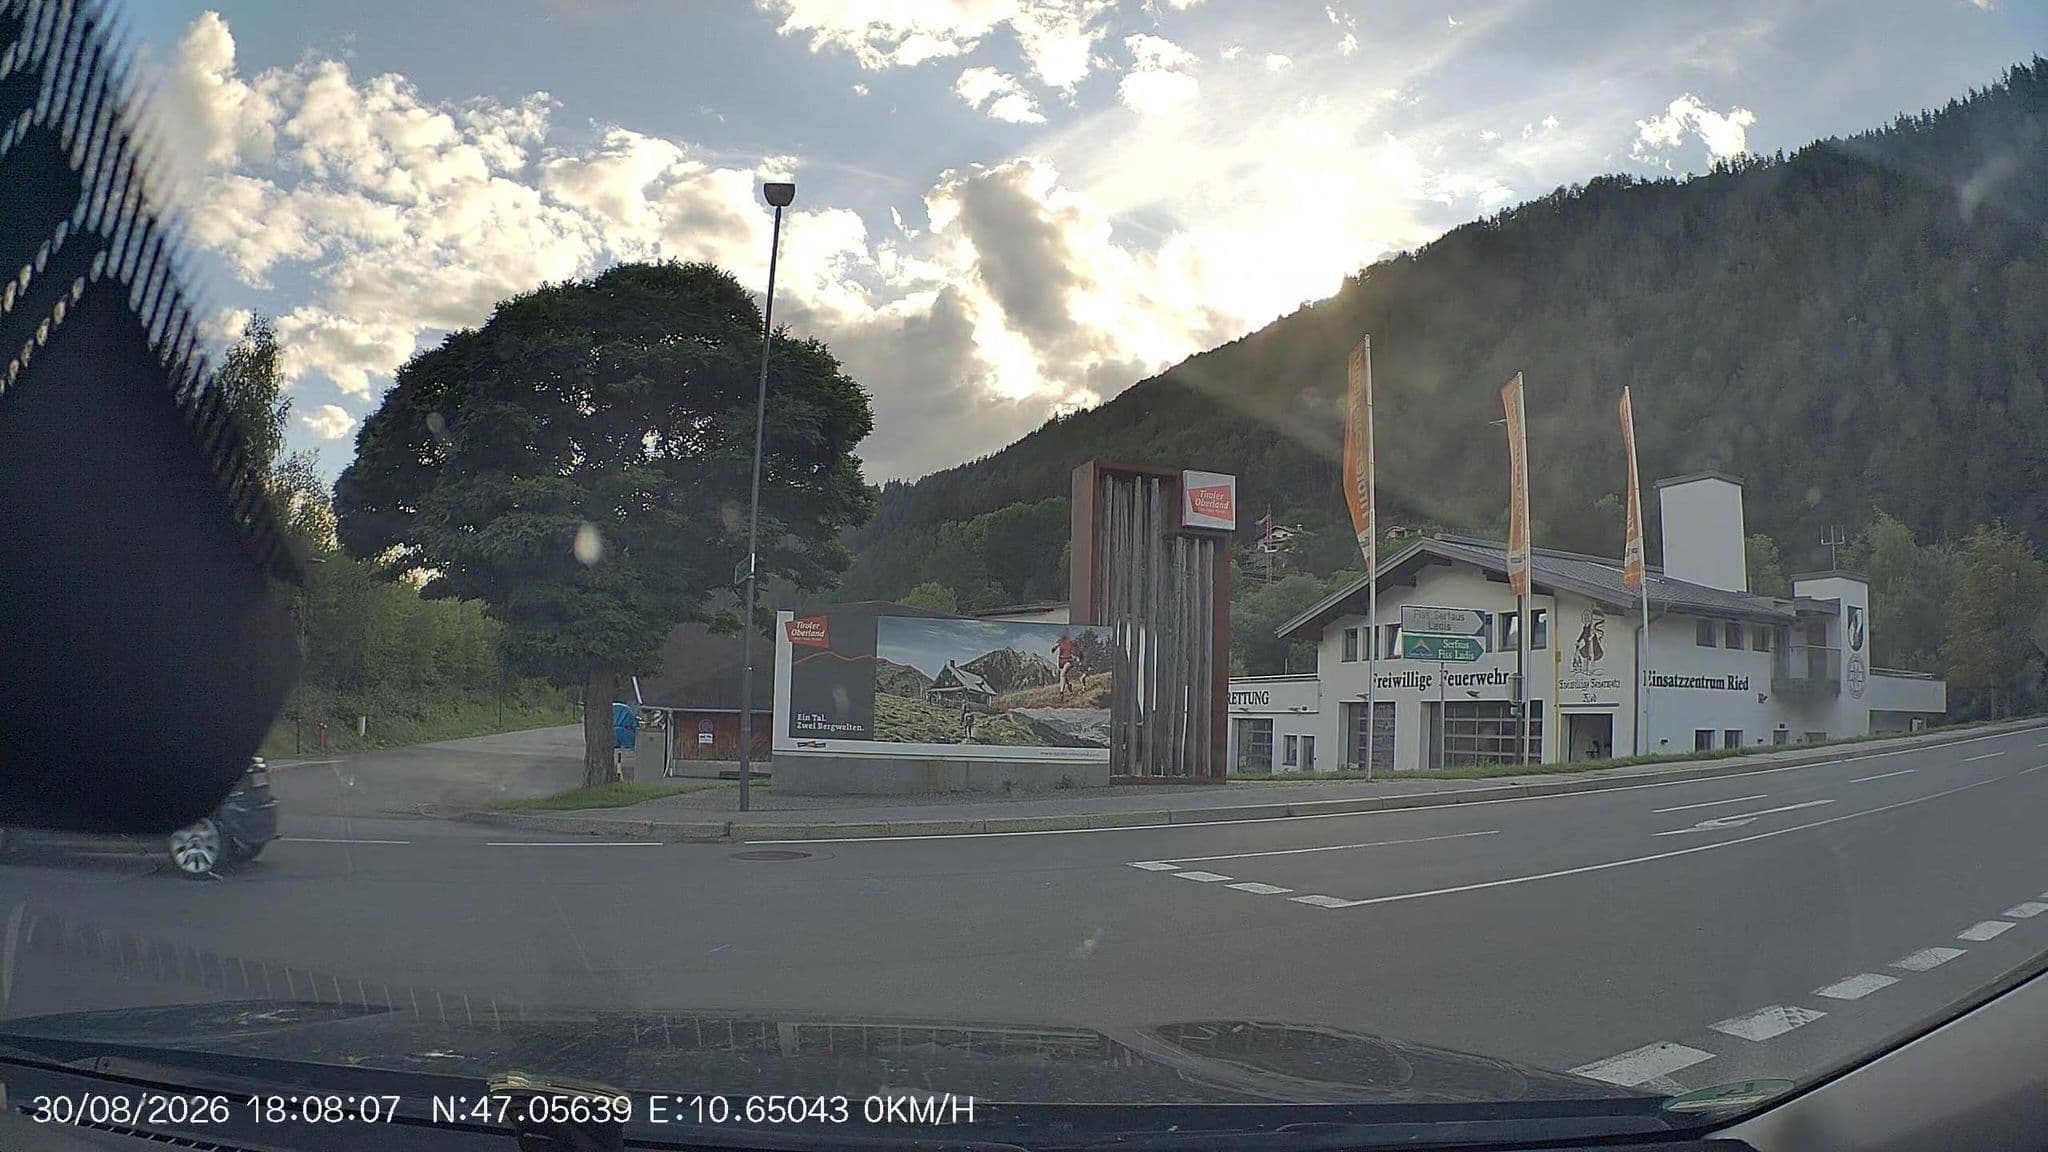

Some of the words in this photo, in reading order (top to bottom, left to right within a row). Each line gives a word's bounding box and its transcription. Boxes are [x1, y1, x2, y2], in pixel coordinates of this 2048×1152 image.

[1200, 489, 1224, 500] Tiroler
[1194, 497, 1230, 510] Oberland
[796, 621, 820, 630] Tiroler
[791, 628, 825, 638] Oberland
[1727, 675, 1749, 691] Ried
[797, 713, 811, 721] Ein
[797, 722, 816, 730] Zwei
[817, 722, 865, 732] Bergwelten.
